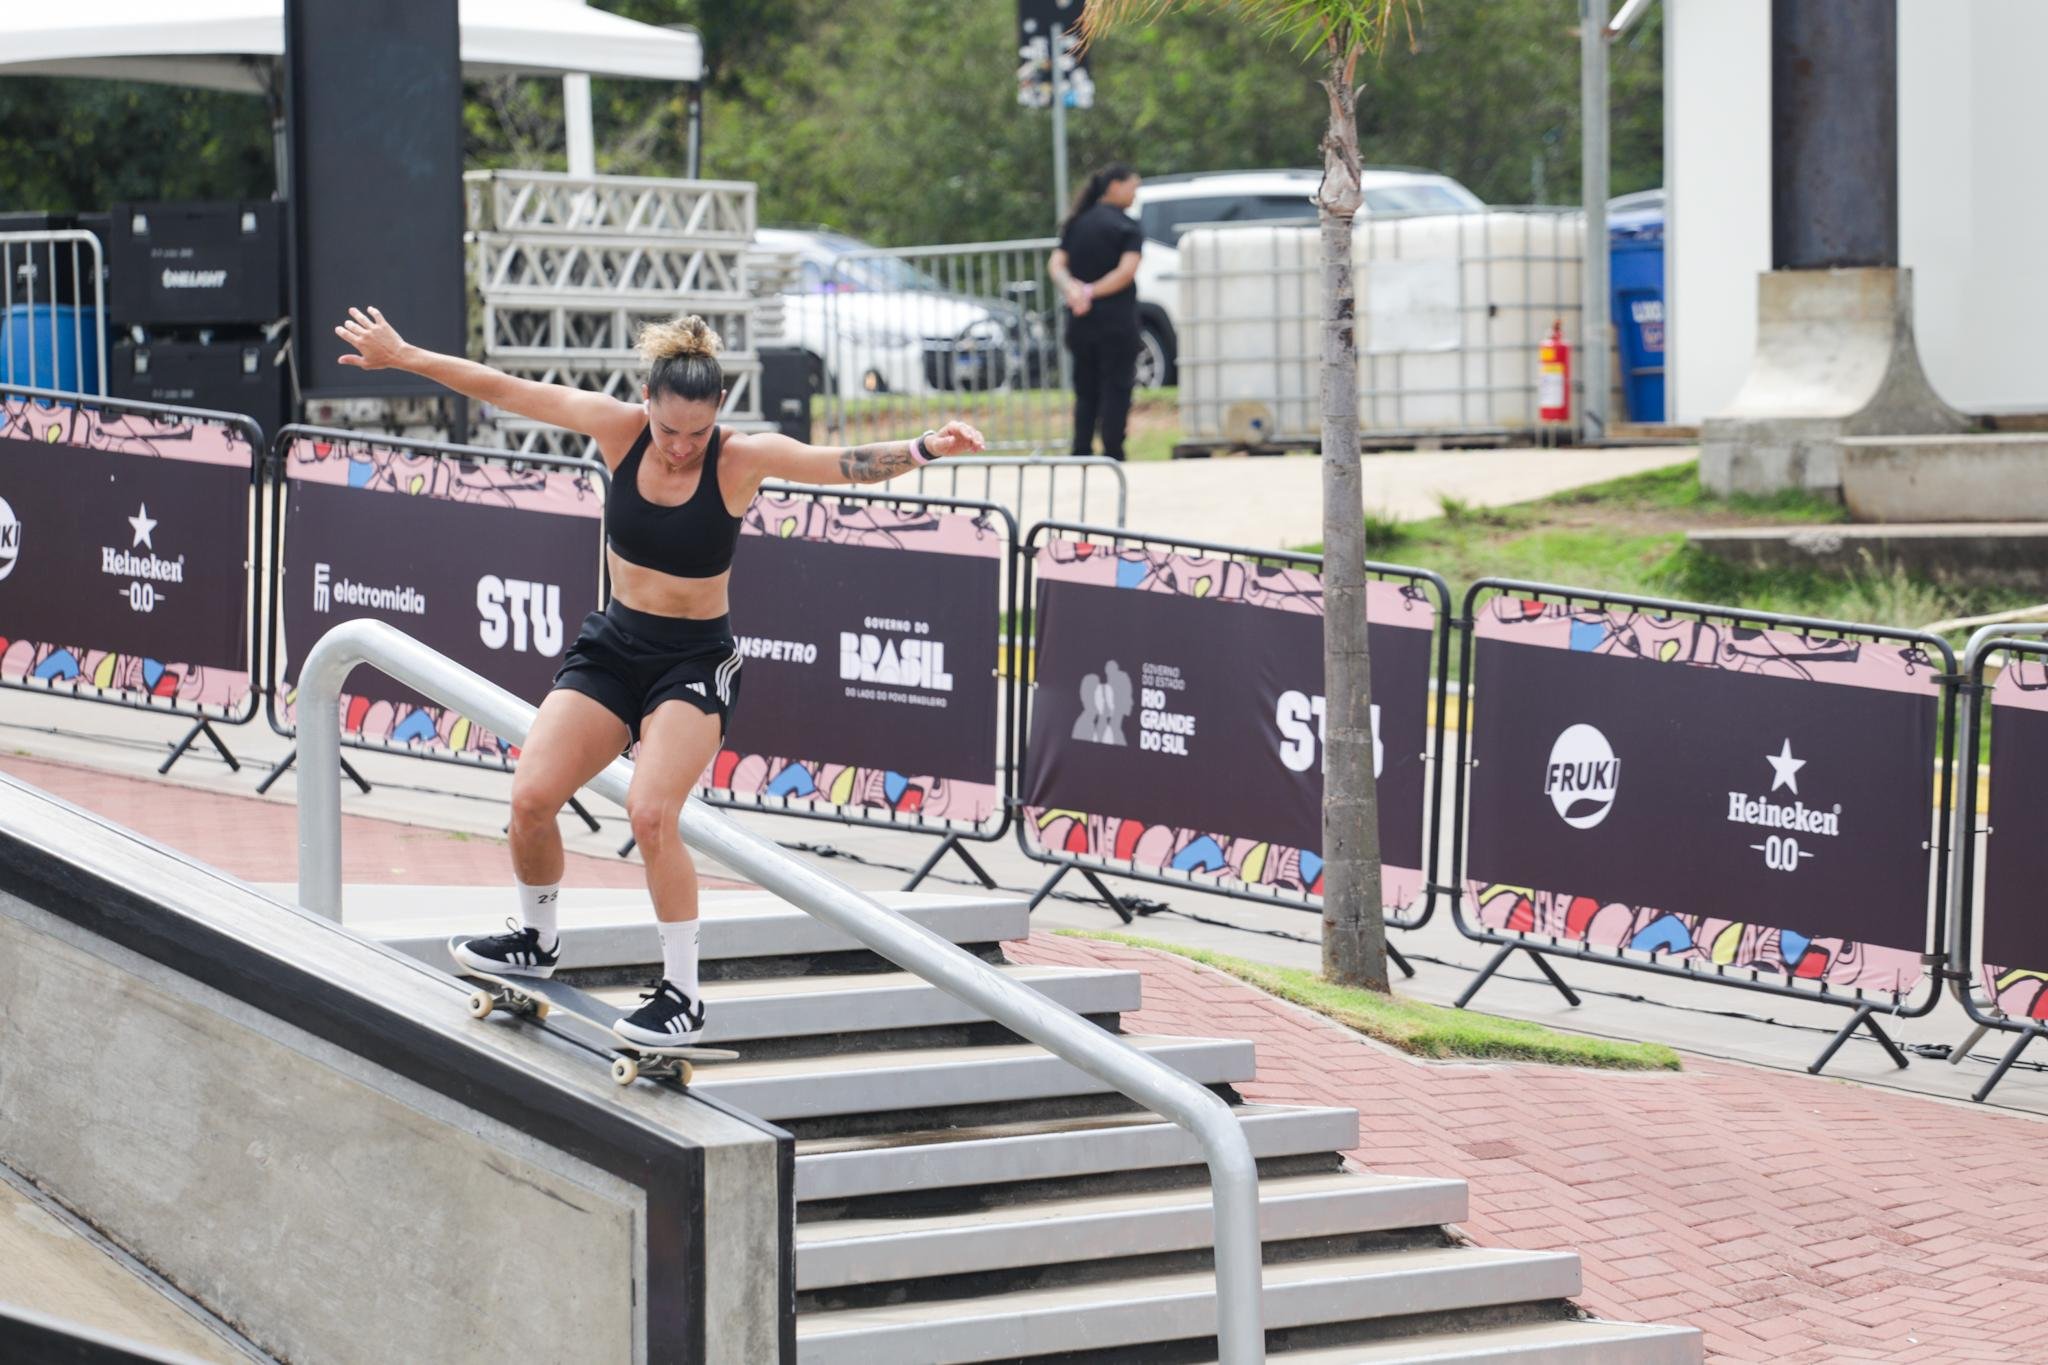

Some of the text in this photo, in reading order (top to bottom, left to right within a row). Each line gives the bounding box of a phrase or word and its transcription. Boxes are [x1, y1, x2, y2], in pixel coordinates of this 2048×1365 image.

[102, 546, 183, 583] Heineken
[334, 578, 425, 615] eletromidia
[477, 574, 563, 658] STU
[864, 616, 930, 635] GOVERNO DO
[840, 631, 953, 691] BRASIL
[1142, 662, 1181, 679] GOVERNO
[1142, 673, 1186, 691] DO ESTADO
[1141, 687, 1166, 710] RIO
[1140, 709, 1196, 737] GRANDE
[1140, 730, 1188, 756] DO SUL
[1547, 760, 1618, 792] FRUKI
[1727, 791, 1840, 836] Heineken
